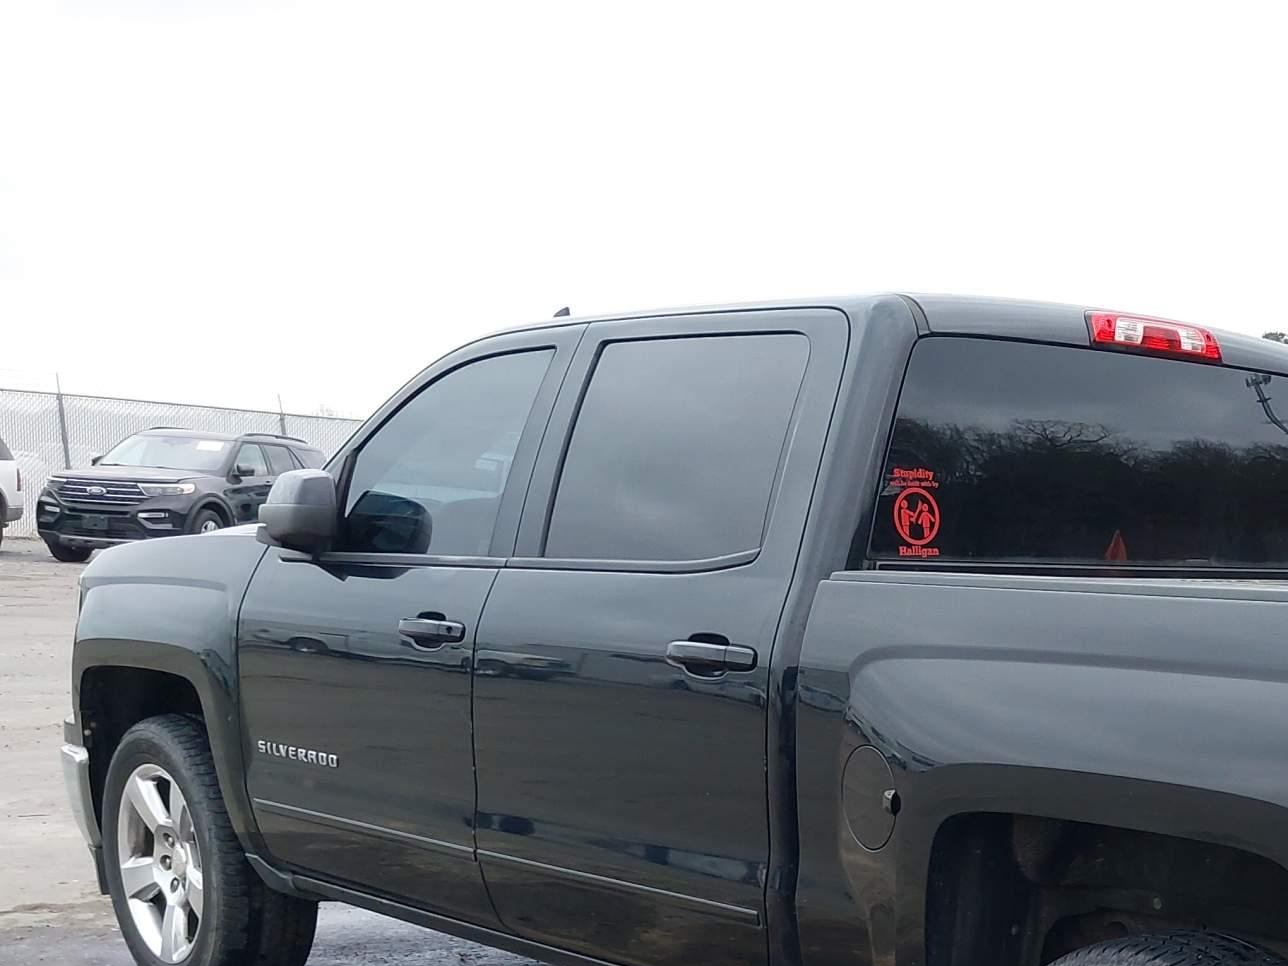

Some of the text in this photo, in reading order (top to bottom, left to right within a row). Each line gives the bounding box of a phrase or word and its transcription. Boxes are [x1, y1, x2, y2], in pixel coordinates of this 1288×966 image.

[893, 468, 934, 480] Stupidity
[899, 546, 939, 557] Halligan
[257, 739, 339, 768] SILVERADO
